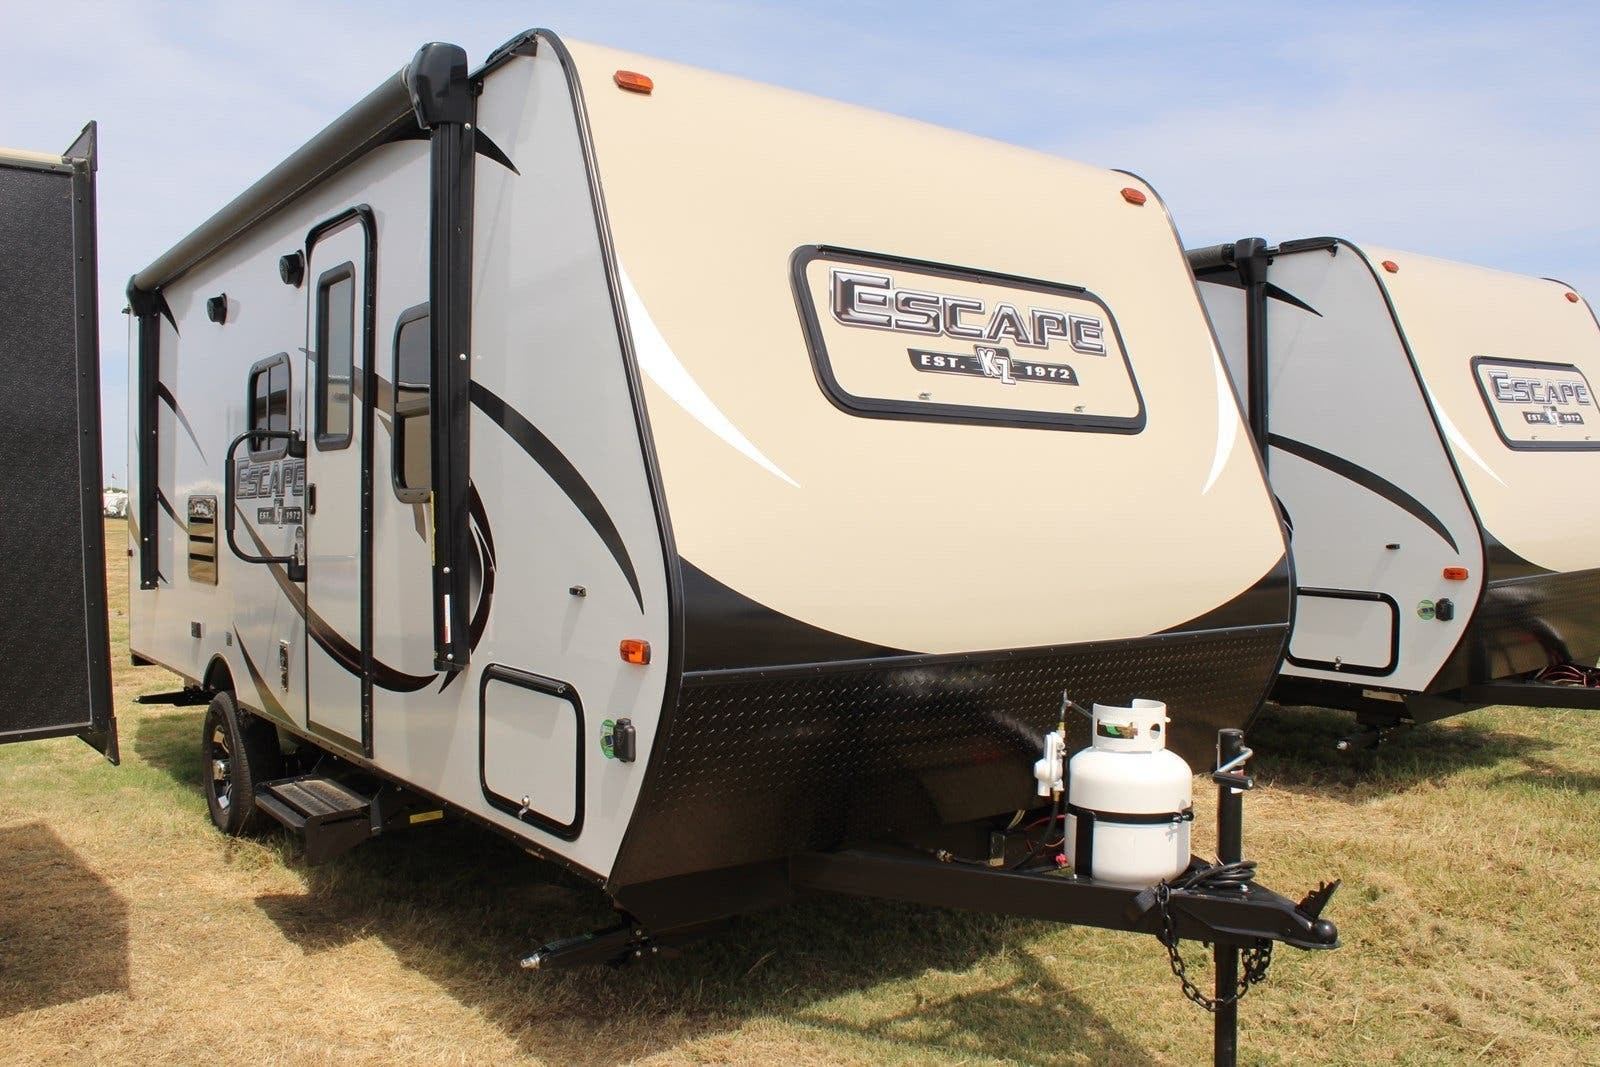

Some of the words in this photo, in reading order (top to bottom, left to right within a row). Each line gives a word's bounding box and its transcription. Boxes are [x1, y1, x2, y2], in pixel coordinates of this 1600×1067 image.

[830, 267, 1106, 356] ESCAPE
[921, 355, 966, 369] EST.
[1025, 365, 1070, 380] 1972
[1489, 371, 1590, 405] ESCAPE
